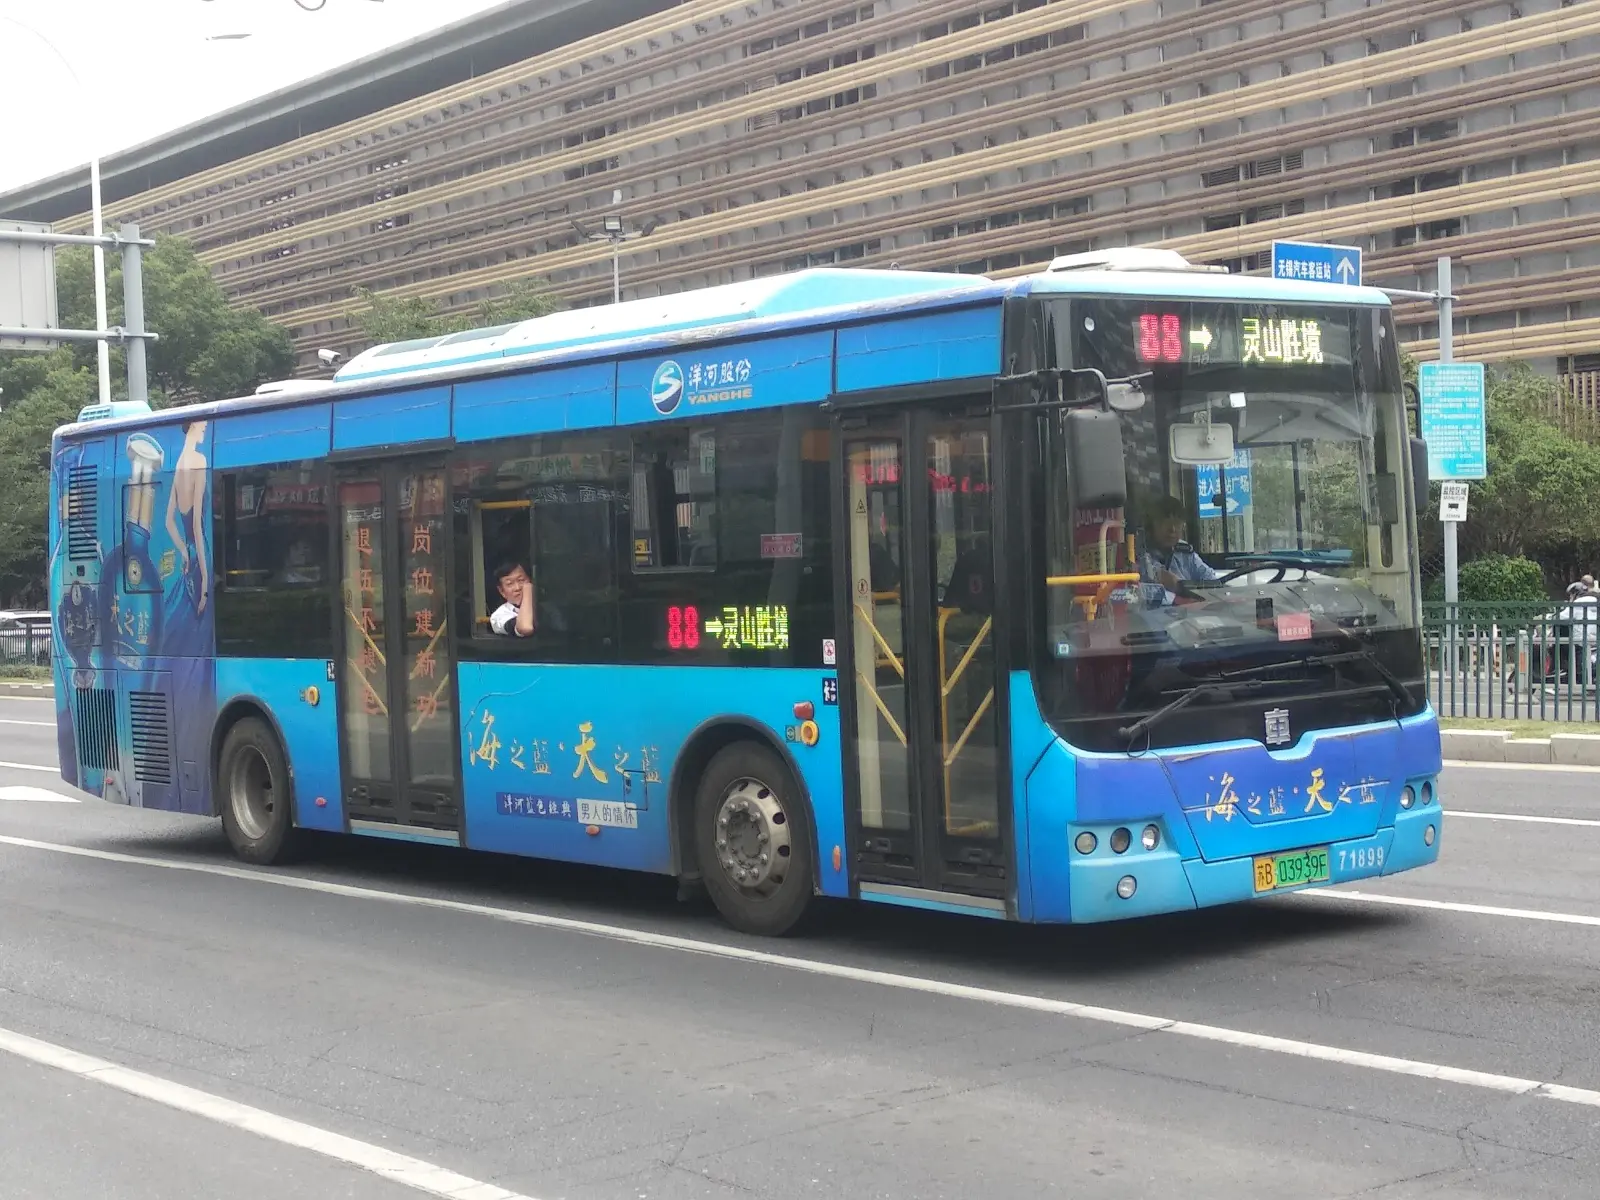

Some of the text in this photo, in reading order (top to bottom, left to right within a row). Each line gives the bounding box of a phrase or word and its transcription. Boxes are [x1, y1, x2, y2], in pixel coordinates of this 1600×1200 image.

[1277, 259, 1332, 280] 无锡汽车客运站
[1140, 314, 1324, 365] 88 灵山胜境
[687, 358, 752, 392] 洋河股份
[687, 387, 753, 405] YANGHE
[411, 523, 440, 721] 岗位建新功
[667, 605, 789, 649] 88 灵山胜境
[580, 802, 636, 826] 男人的情怀
[1279, 852, 1328, 883] 03939F
[1338, 846, 1384, 872] 71899
